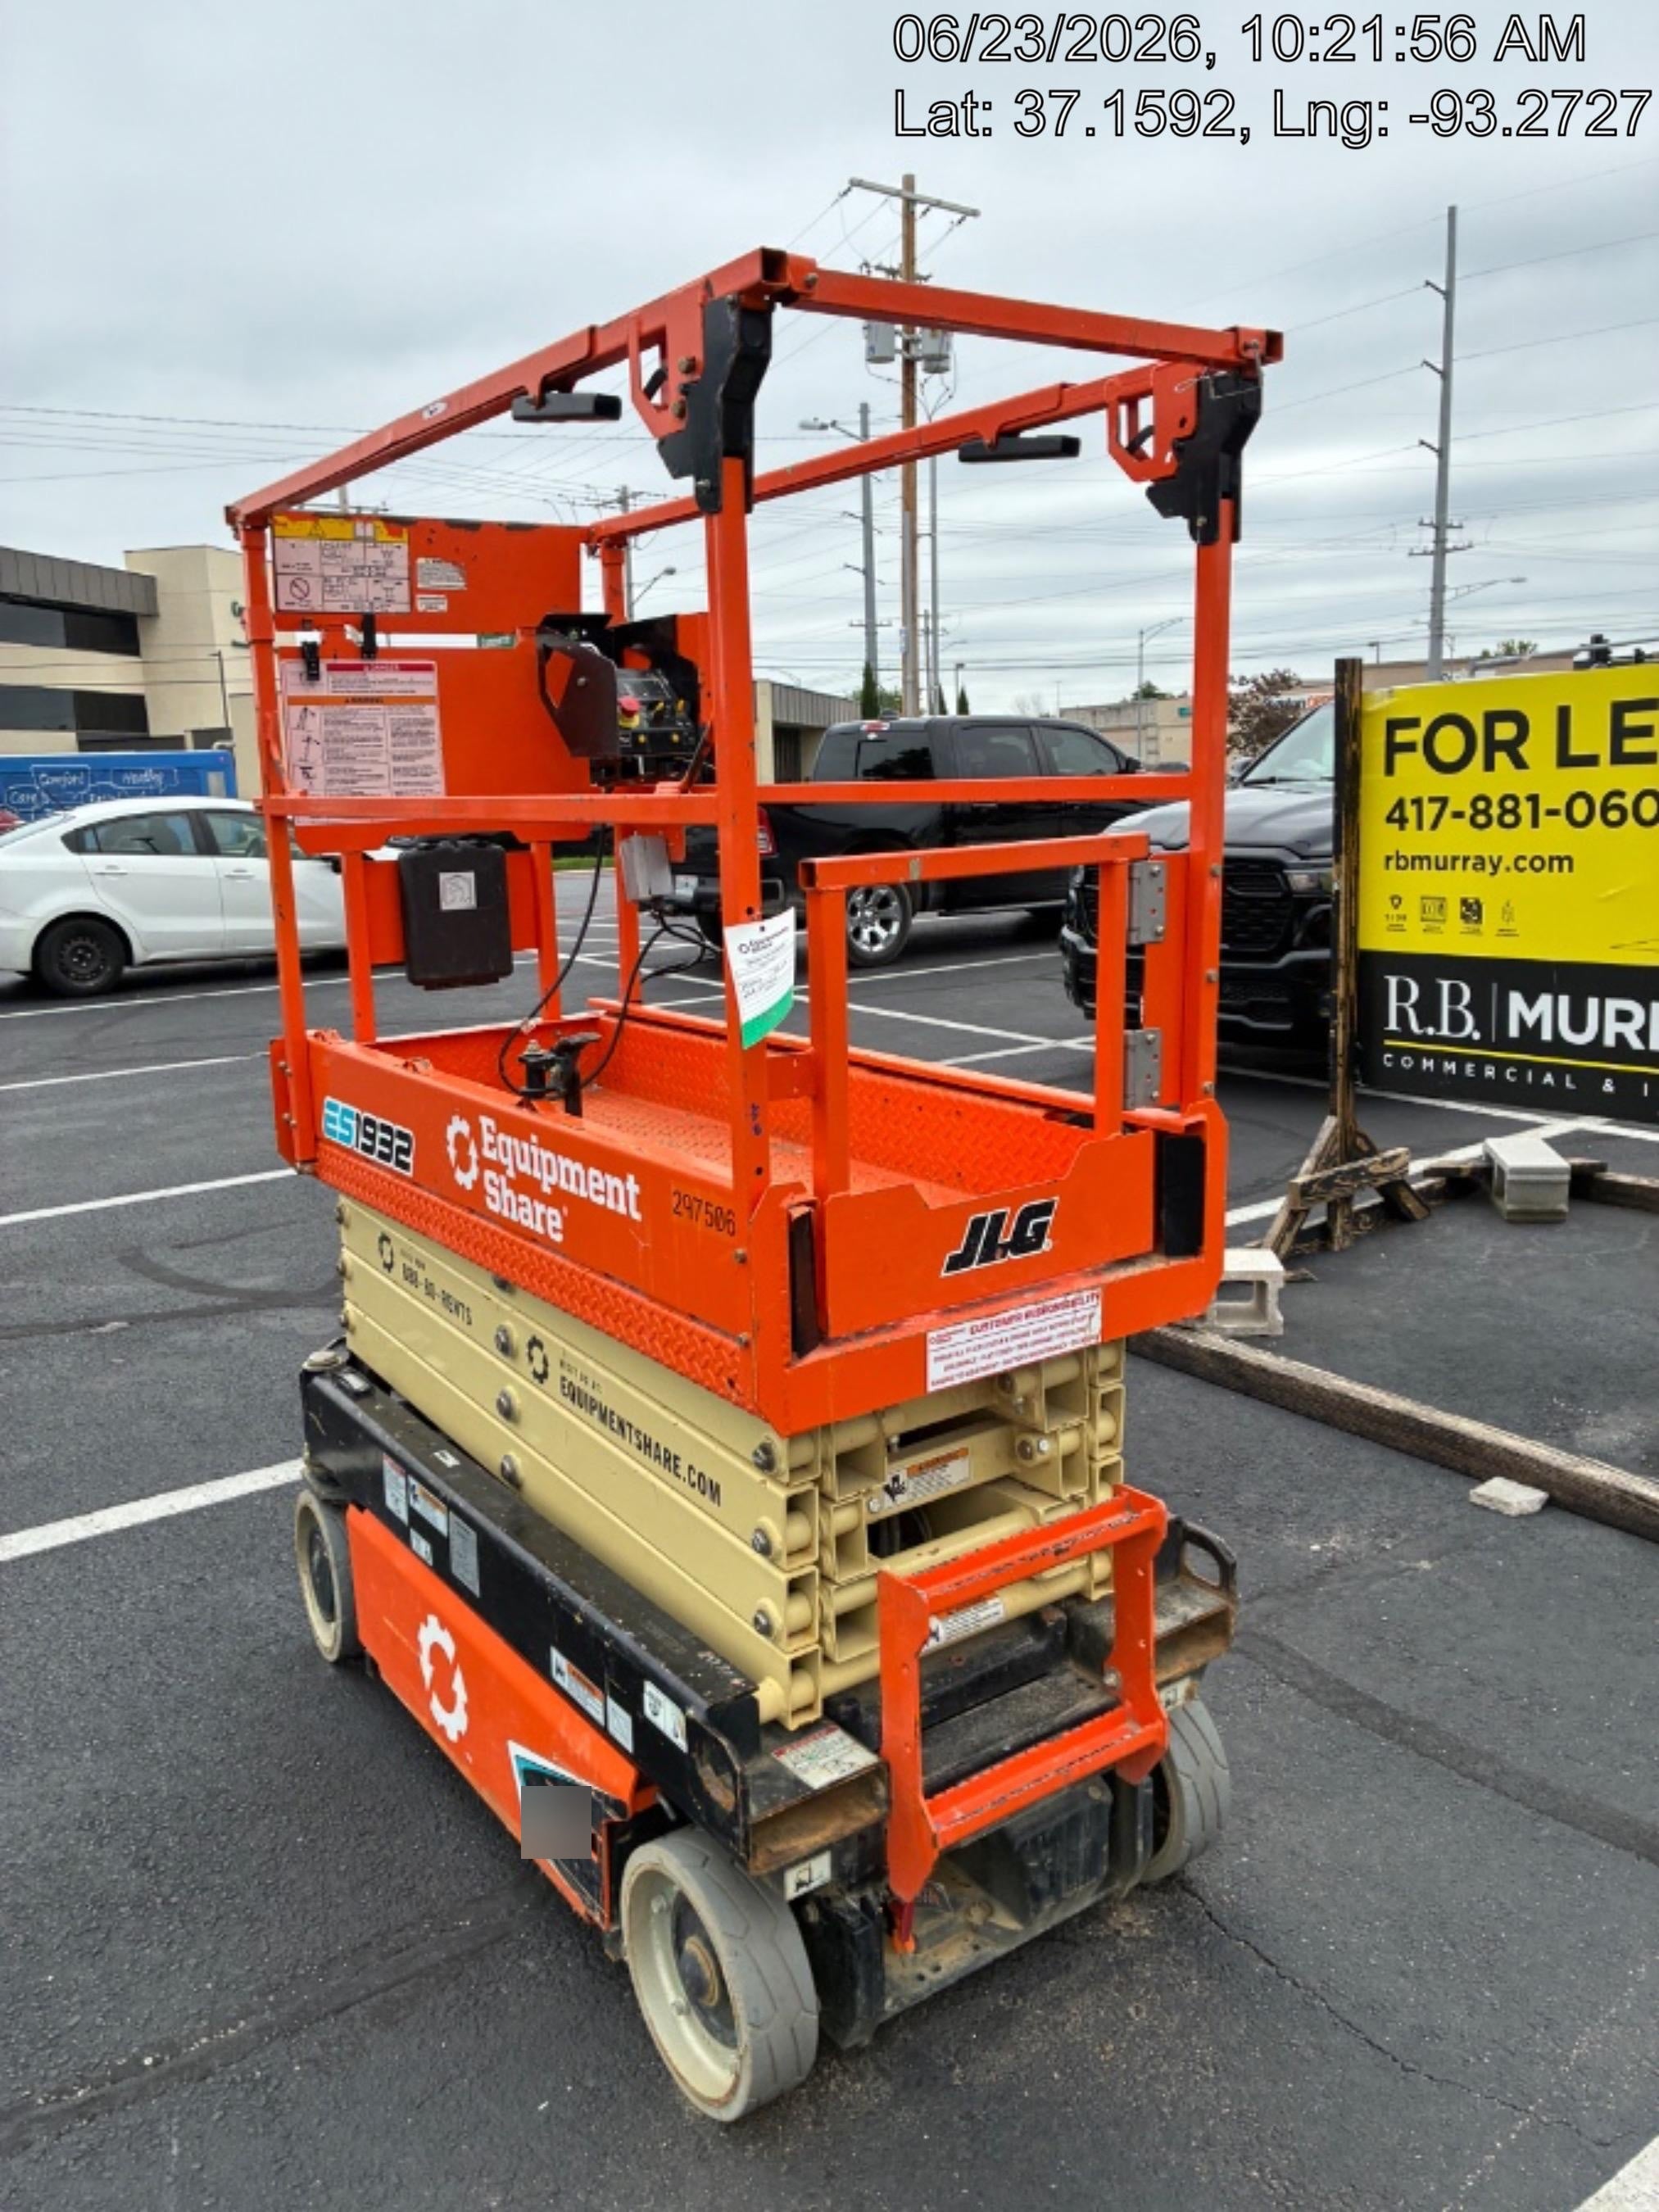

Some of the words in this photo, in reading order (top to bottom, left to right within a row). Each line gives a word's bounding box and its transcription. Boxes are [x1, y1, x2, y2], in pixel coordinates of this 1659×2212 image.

[1384, 709, 1530, 777] FOR
[1384, 850, 1575, 875] rbmurray.com
[1383, 975, 1481, 1041] R.B.
[1383, 1054, 1577, 1090] COMMERCIAL
[1602, 1079, 1616, 1094] &
[324, 1099, 413, 1175] ES1932
[478, 1115, 642, 1222] Equipment
[483, 1168, 564, 1243] Share
[673, 1189, 736, 1237] 297506
[941, 1196, 1058, 1276] JLG
[560, 1376, 721, 1508] EQUIPMENTSHARE.COM
